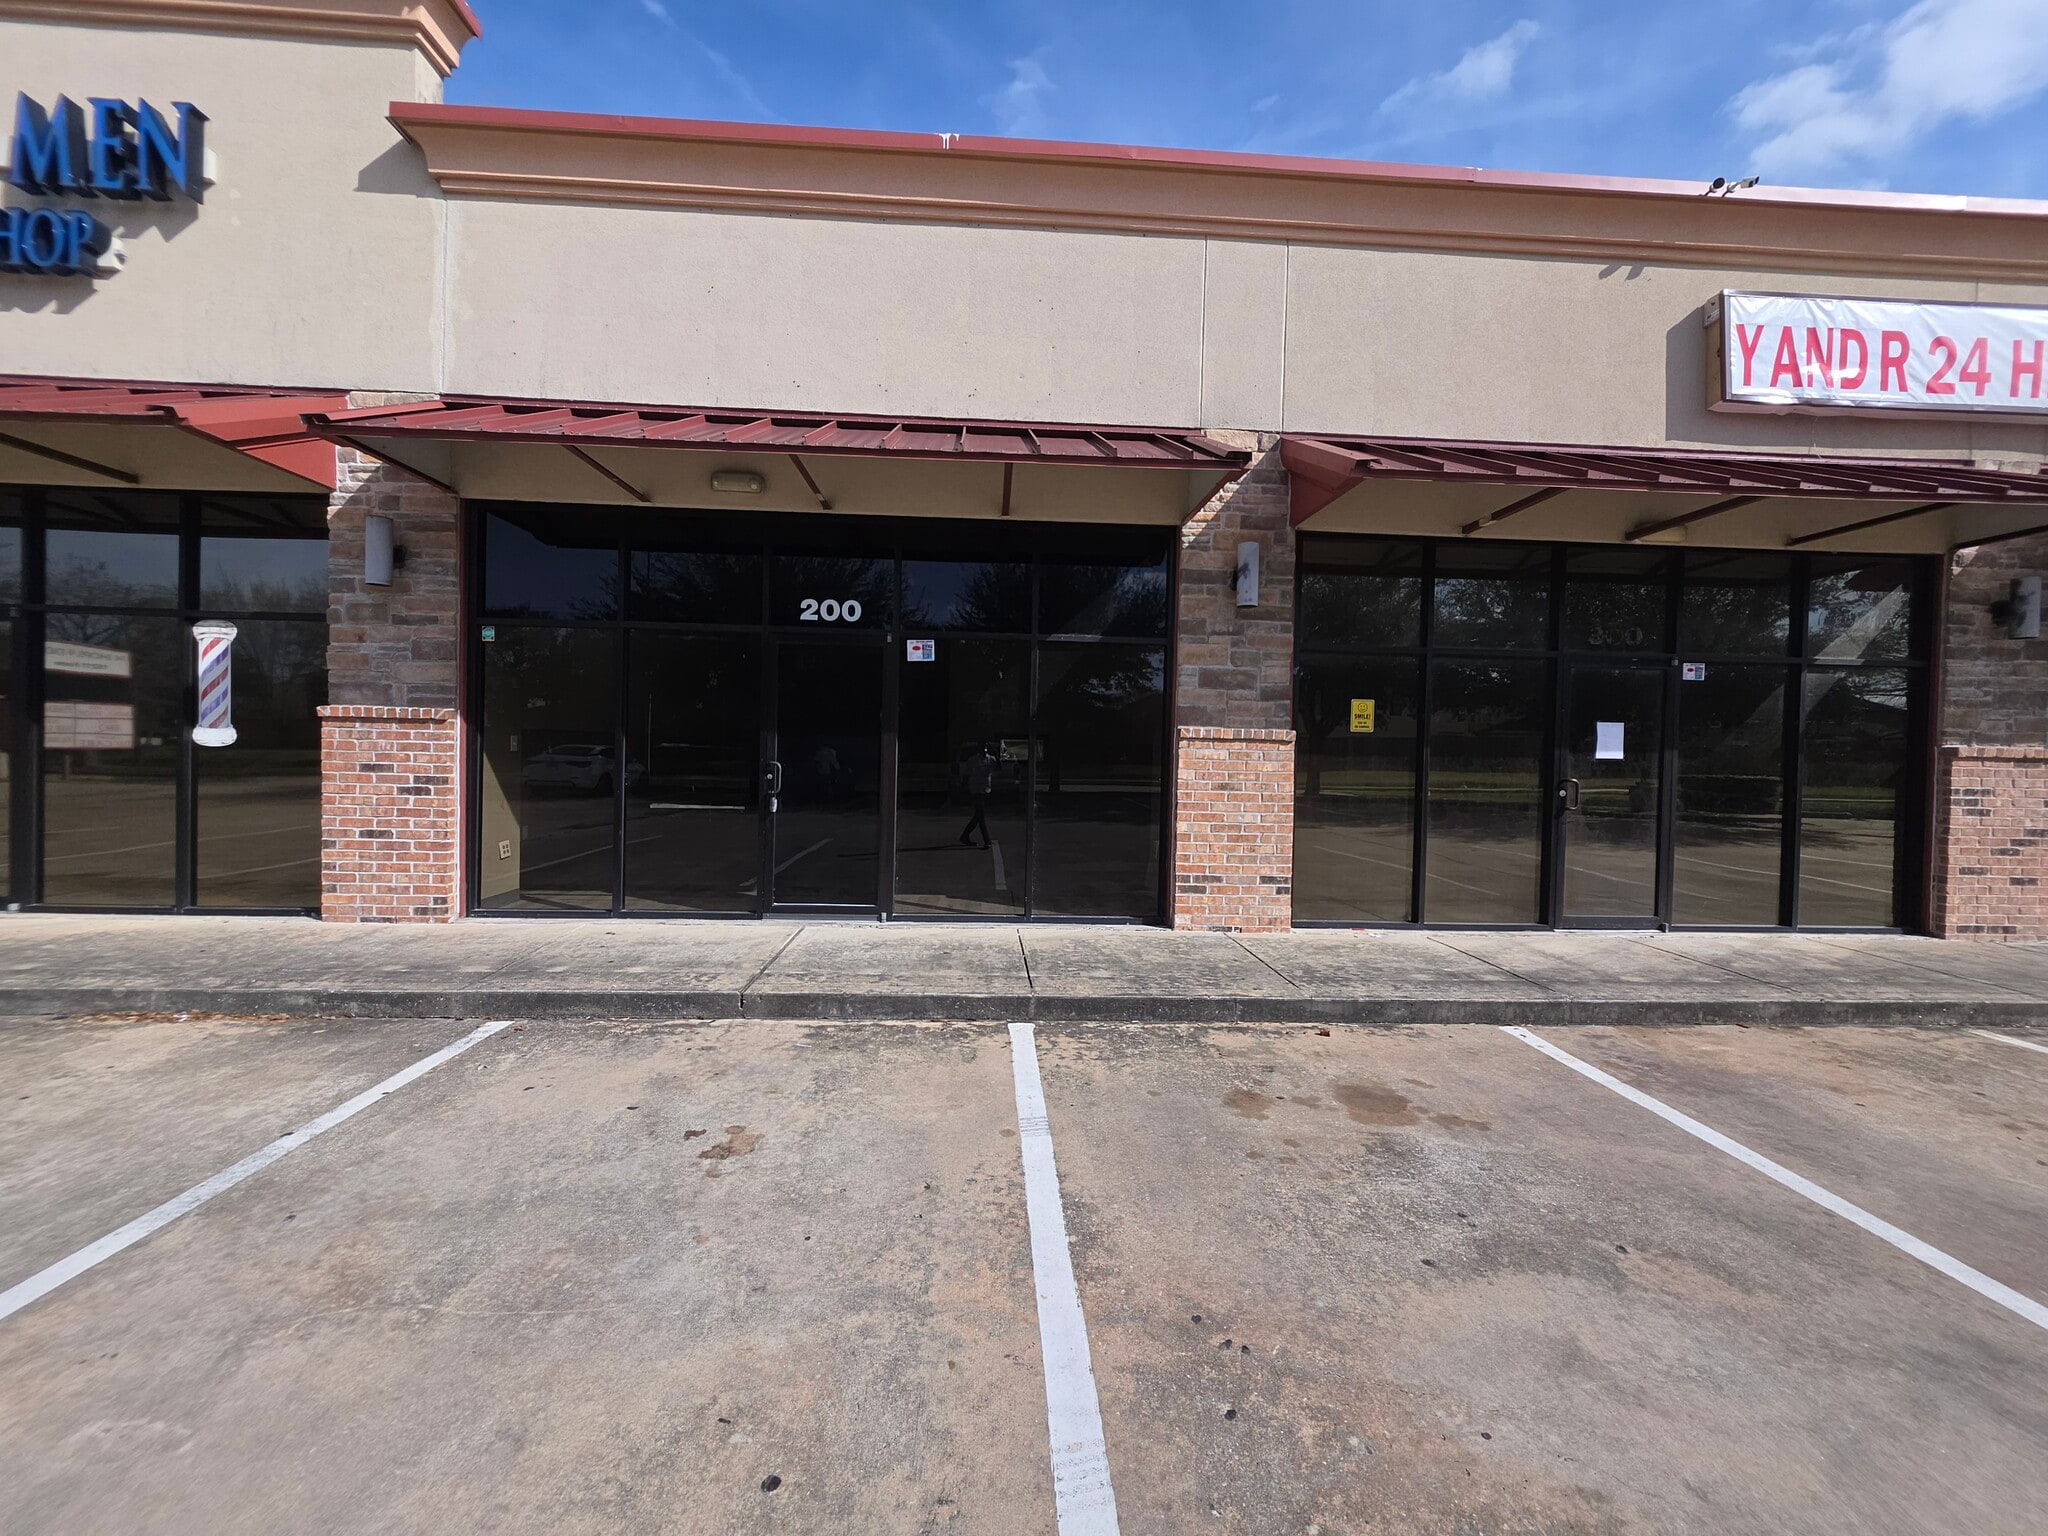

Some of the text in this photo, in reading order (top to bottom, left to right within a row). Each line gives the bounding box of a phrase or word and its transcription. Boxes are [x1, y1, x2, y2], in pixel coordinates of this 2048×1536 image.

[7, 89, 206, 202] MEN
[1925, 335, 1992, 397] 24
[2009, 339, 2048, 399] H
[800, 598, 862, 622] 200
